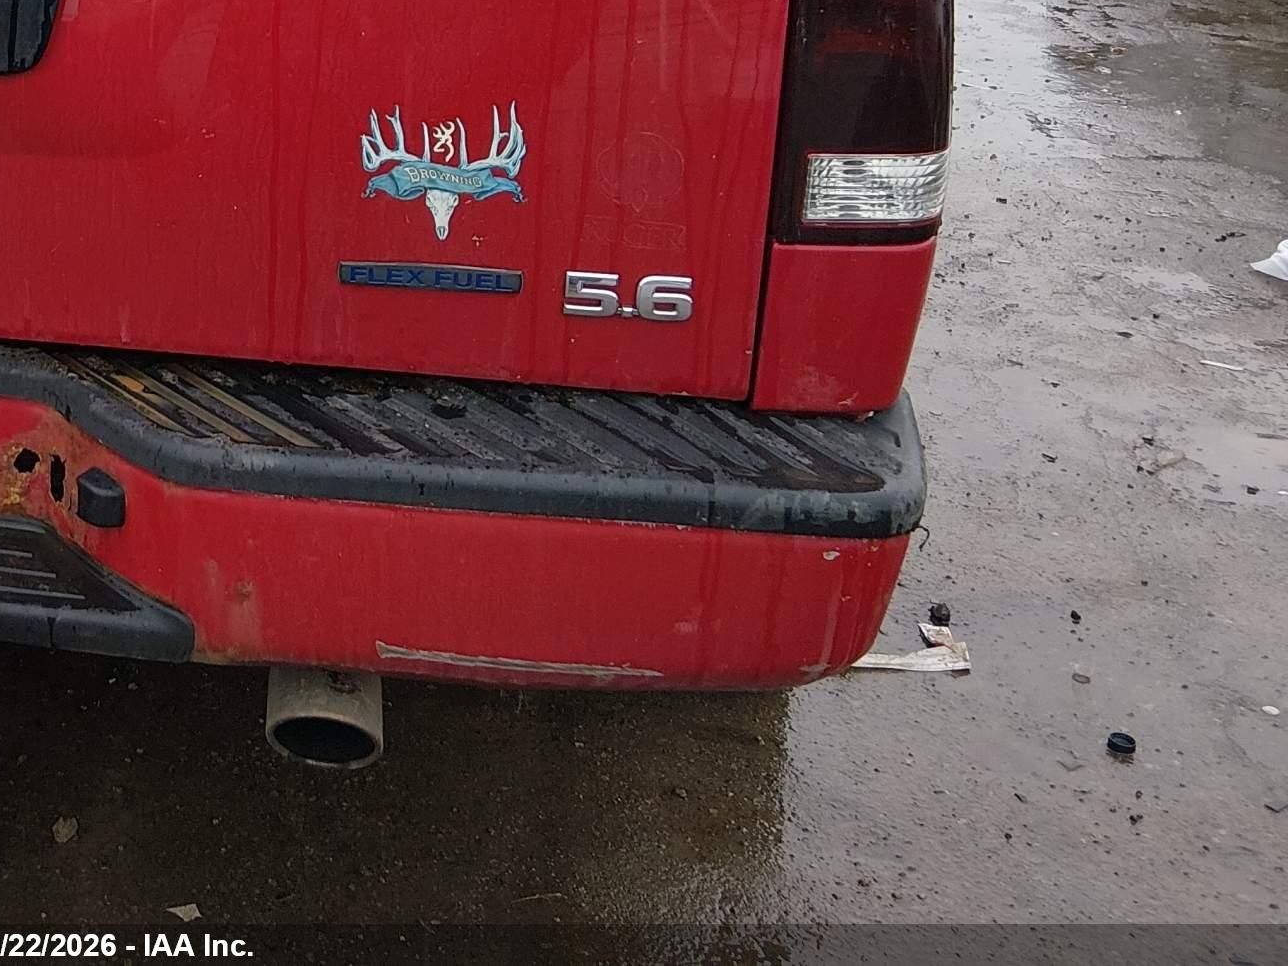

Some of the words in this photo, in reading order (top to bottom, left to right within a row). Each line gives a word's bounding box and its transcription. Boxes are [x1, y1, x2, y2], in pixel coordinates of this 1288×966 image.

[404, 166, 482, 187] BROWNING
[349, 266, 425, 286] FLEX
[434, 270, 513, 292] FUEL
[563, 271, 693, 321] 5.6
